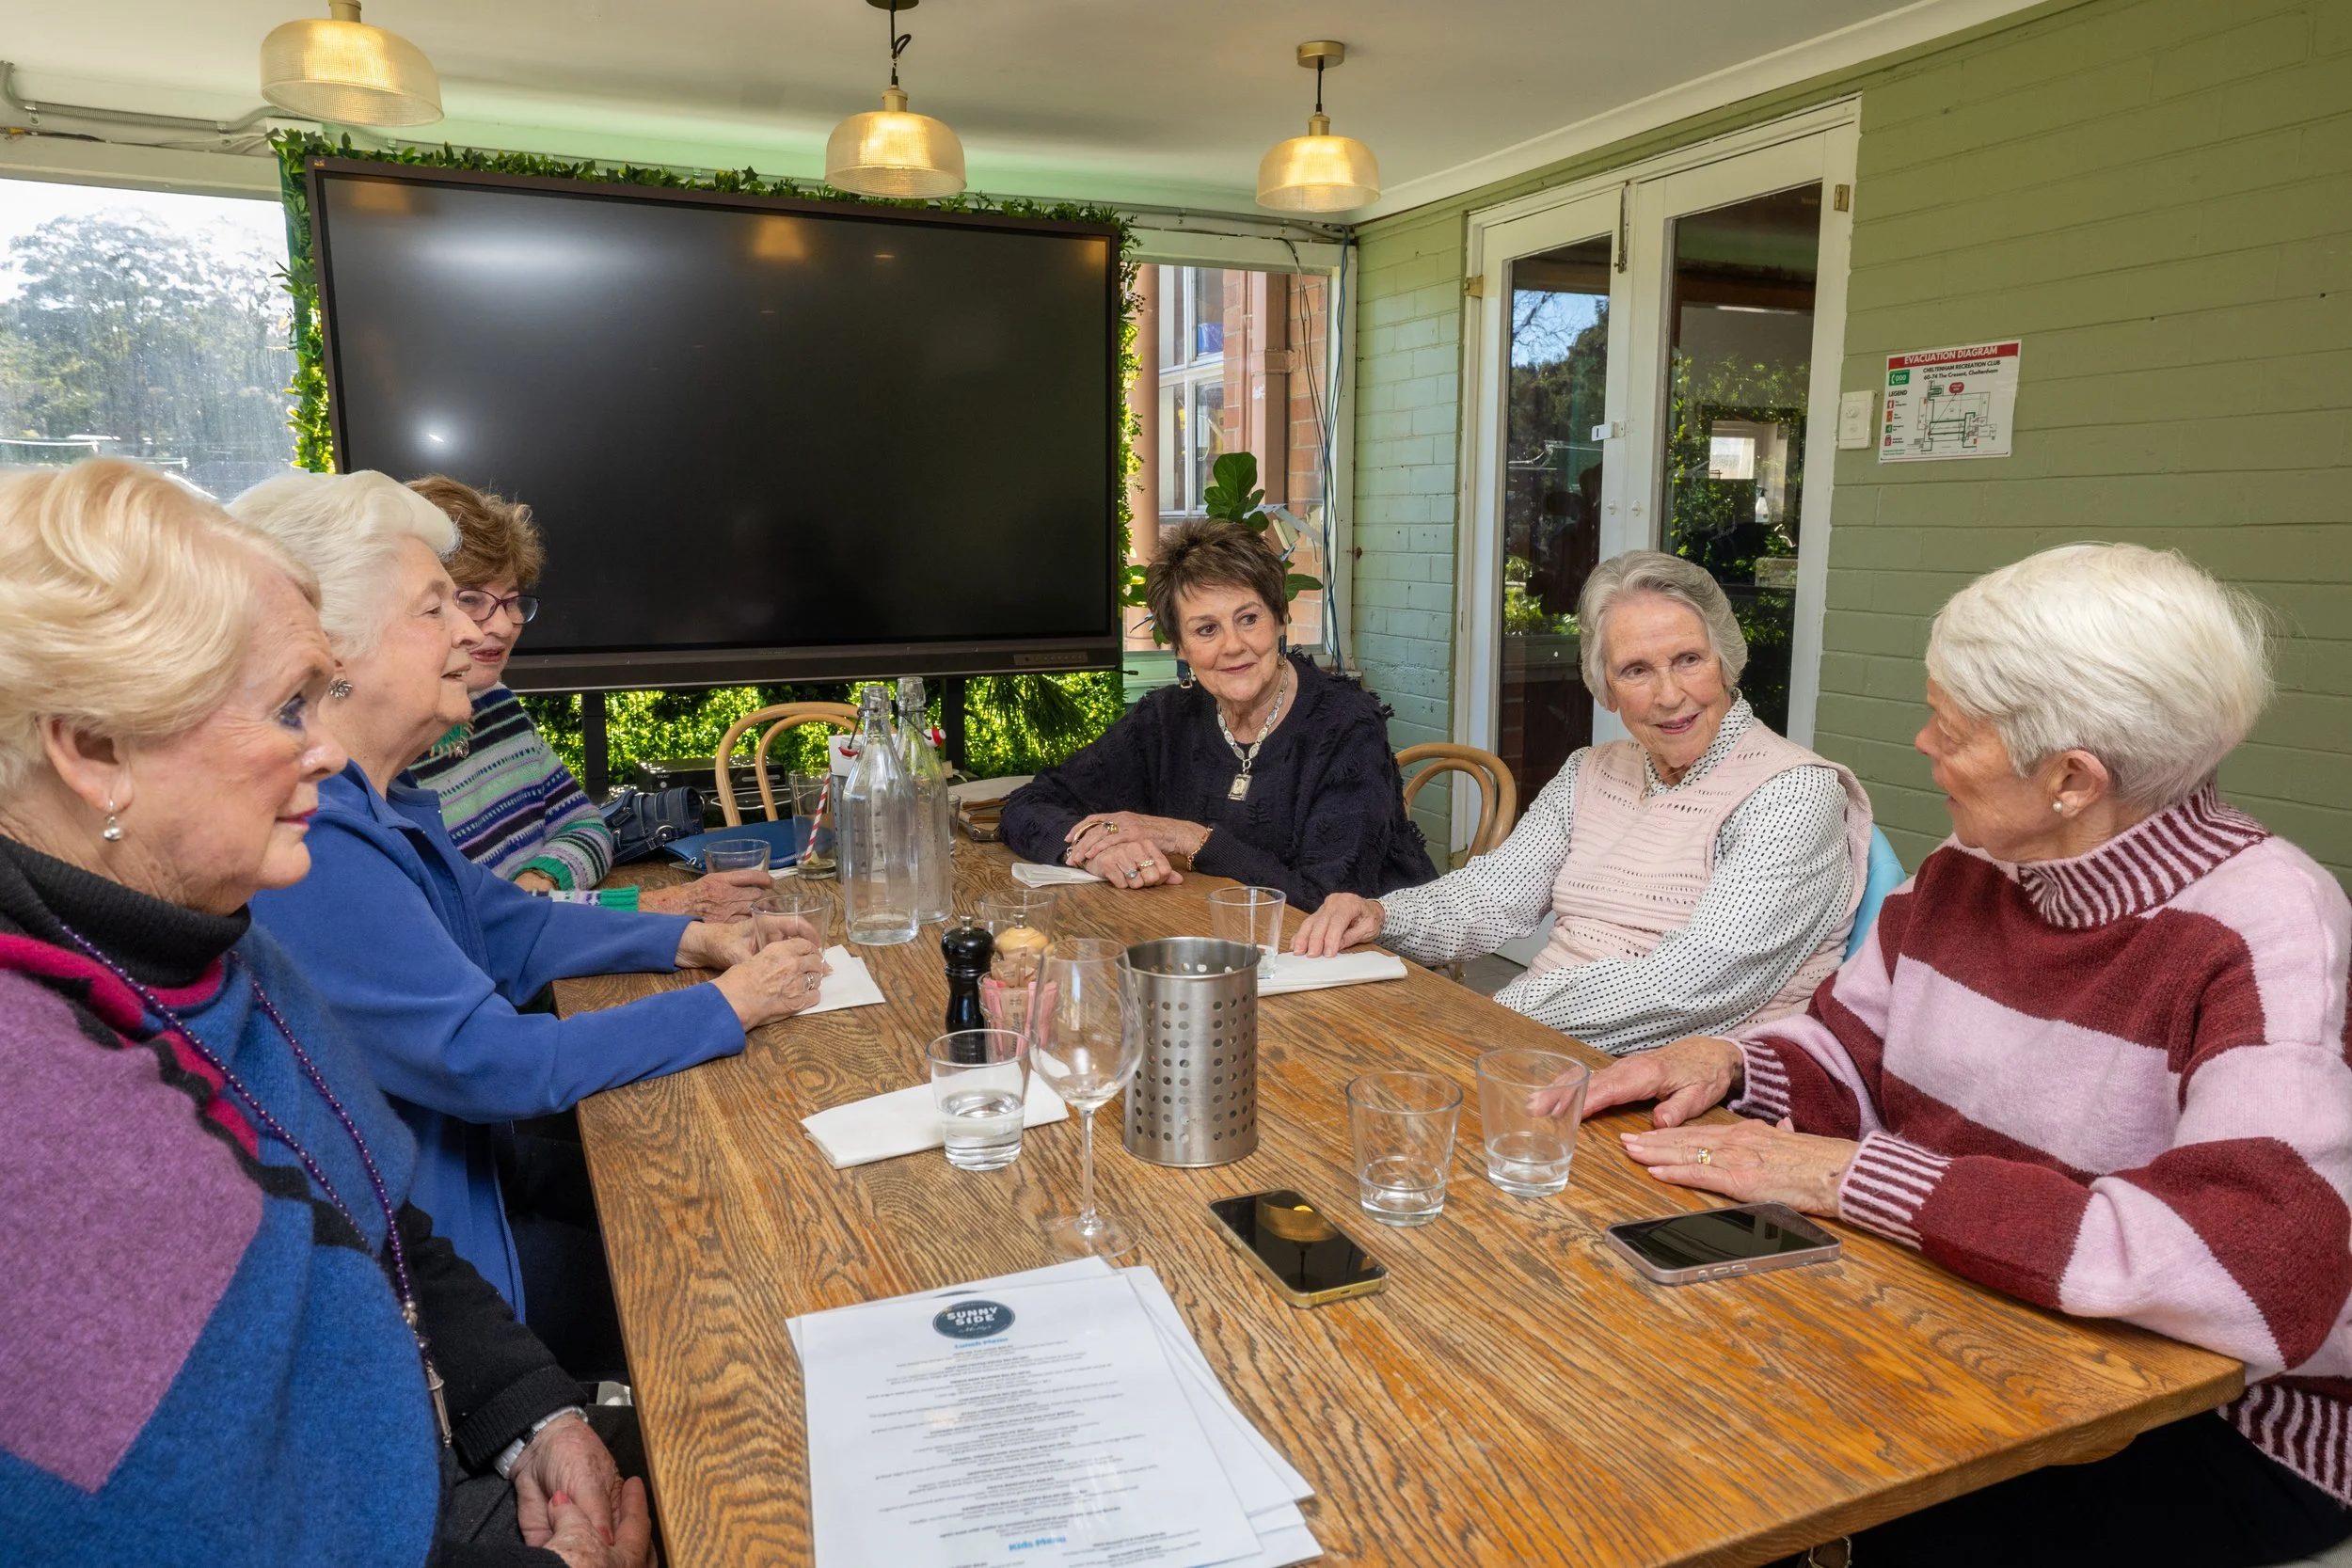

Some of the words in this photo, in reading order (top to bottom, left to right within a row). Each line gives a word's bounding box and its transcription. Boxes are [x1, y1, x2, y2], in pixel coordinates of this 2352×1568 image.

[1904, 352, 1956, 365] EVACUATION
[1958, 346, 1998, 357] DIAGRAM
[947, 1307, 997, 1320] SUNNY
[955, 1314, 995, 1326] SIDE
[1009, 1542, 1033, 1550] Kids
[1035, 1536, 1066, 1546] Menu
